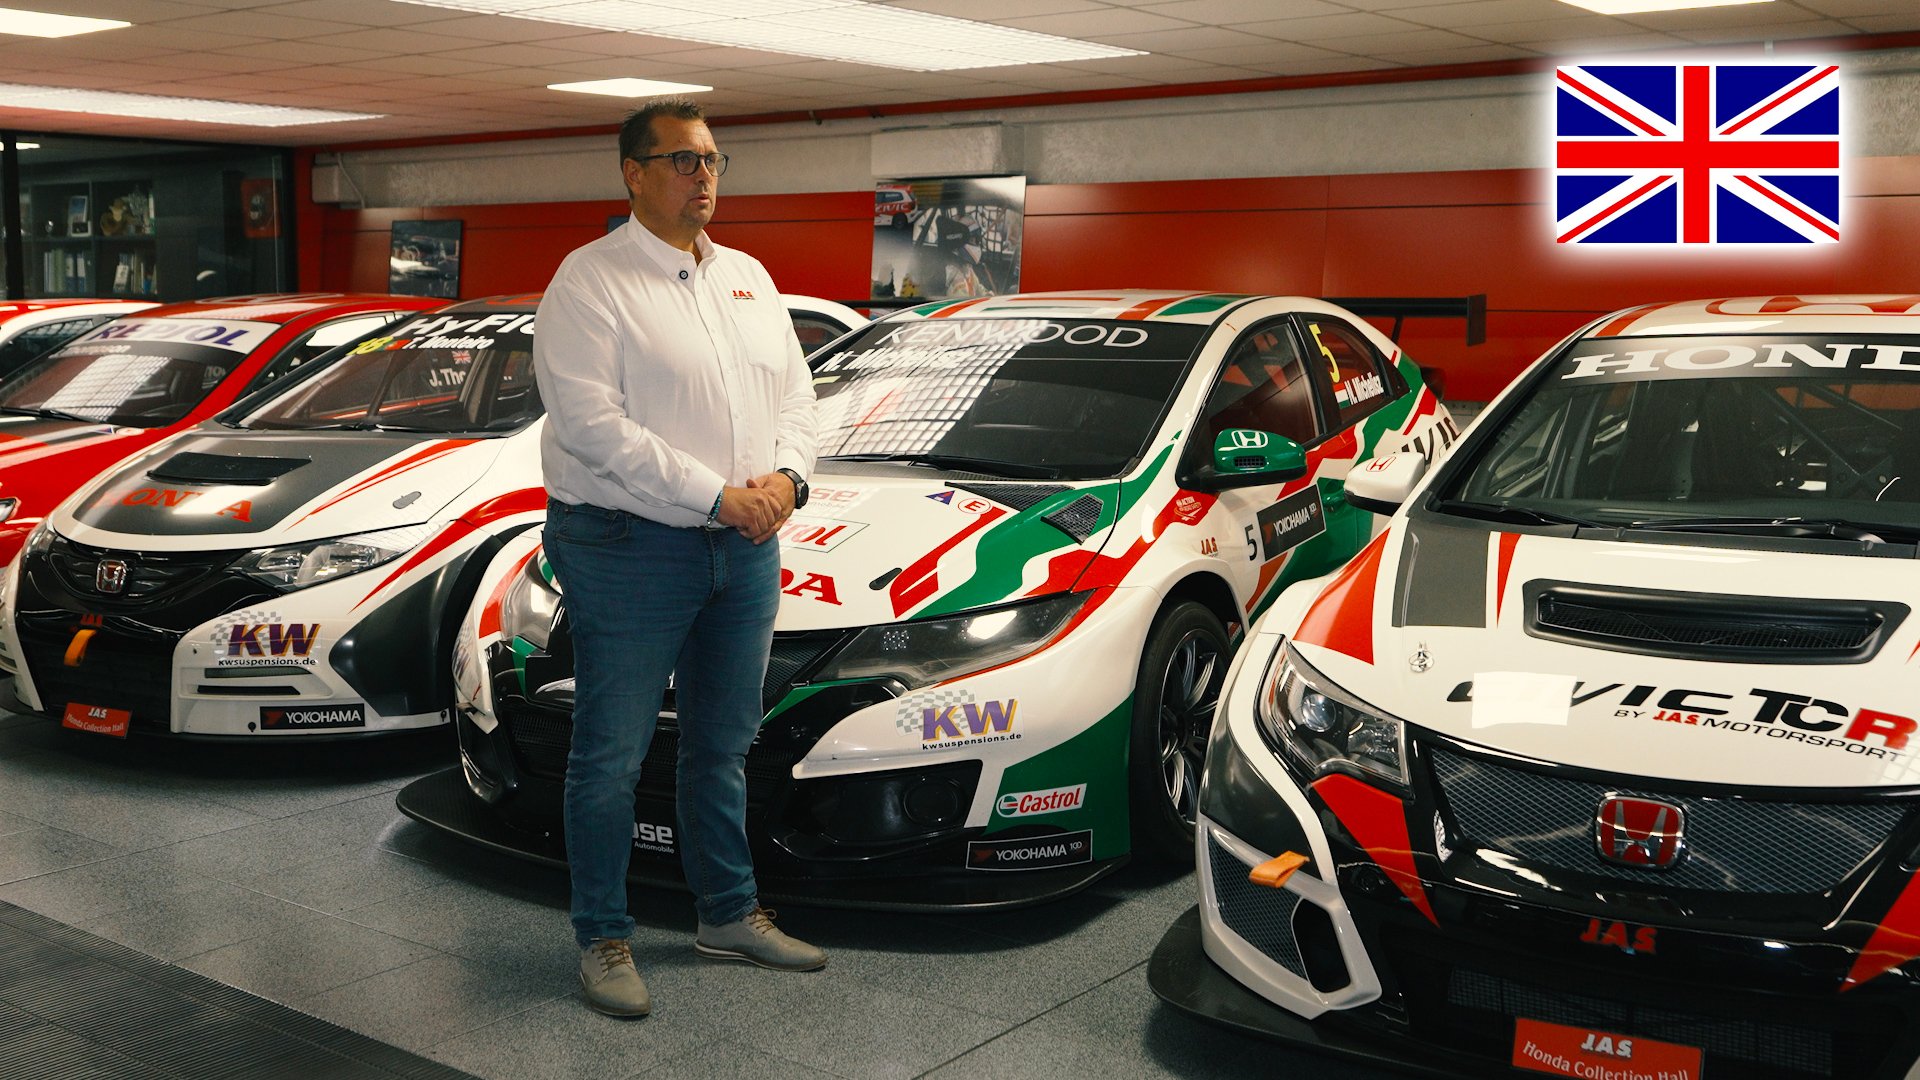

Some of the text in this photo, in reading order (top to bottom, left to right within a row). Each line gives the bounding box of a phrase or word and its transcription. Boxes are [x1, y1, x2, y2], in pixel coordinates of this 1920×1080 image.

[402, 335, 495, 350] T. Monteiro
[875, 323, 1149, 348] KENWOOD
[1308, 323, 1340, 384] 5
[1561, 342, 1920, 380] HOND
[1273, 506, 1311, 537] YOKOHAMA
[1244, 524, 1258, 561] 5
[227, 623, 321, 657] KW
[218, 657, 317, 667] kwsuspensions.de
[285, 710, 362, 724] YOKOHAMA
[922, 698, 1018, 742] KW
[1737, 688, 1919, 751] TCR
[922, 733, 1023, 751] kwsuspensions.de
[1613, 708, 1907, 763] BY JAS MOTORSPORT
[1019, 787, 1081, 814] Castrol
[996, 844, 1068, 862] YOKOHAMA
[1579, 917, 1658, 954] JAS
[1522, 1041, 1571, 1073] Honda
[1573, 1061, 1654, 1080] Collection
[1580, 1032, 1633, 1059] JAS
